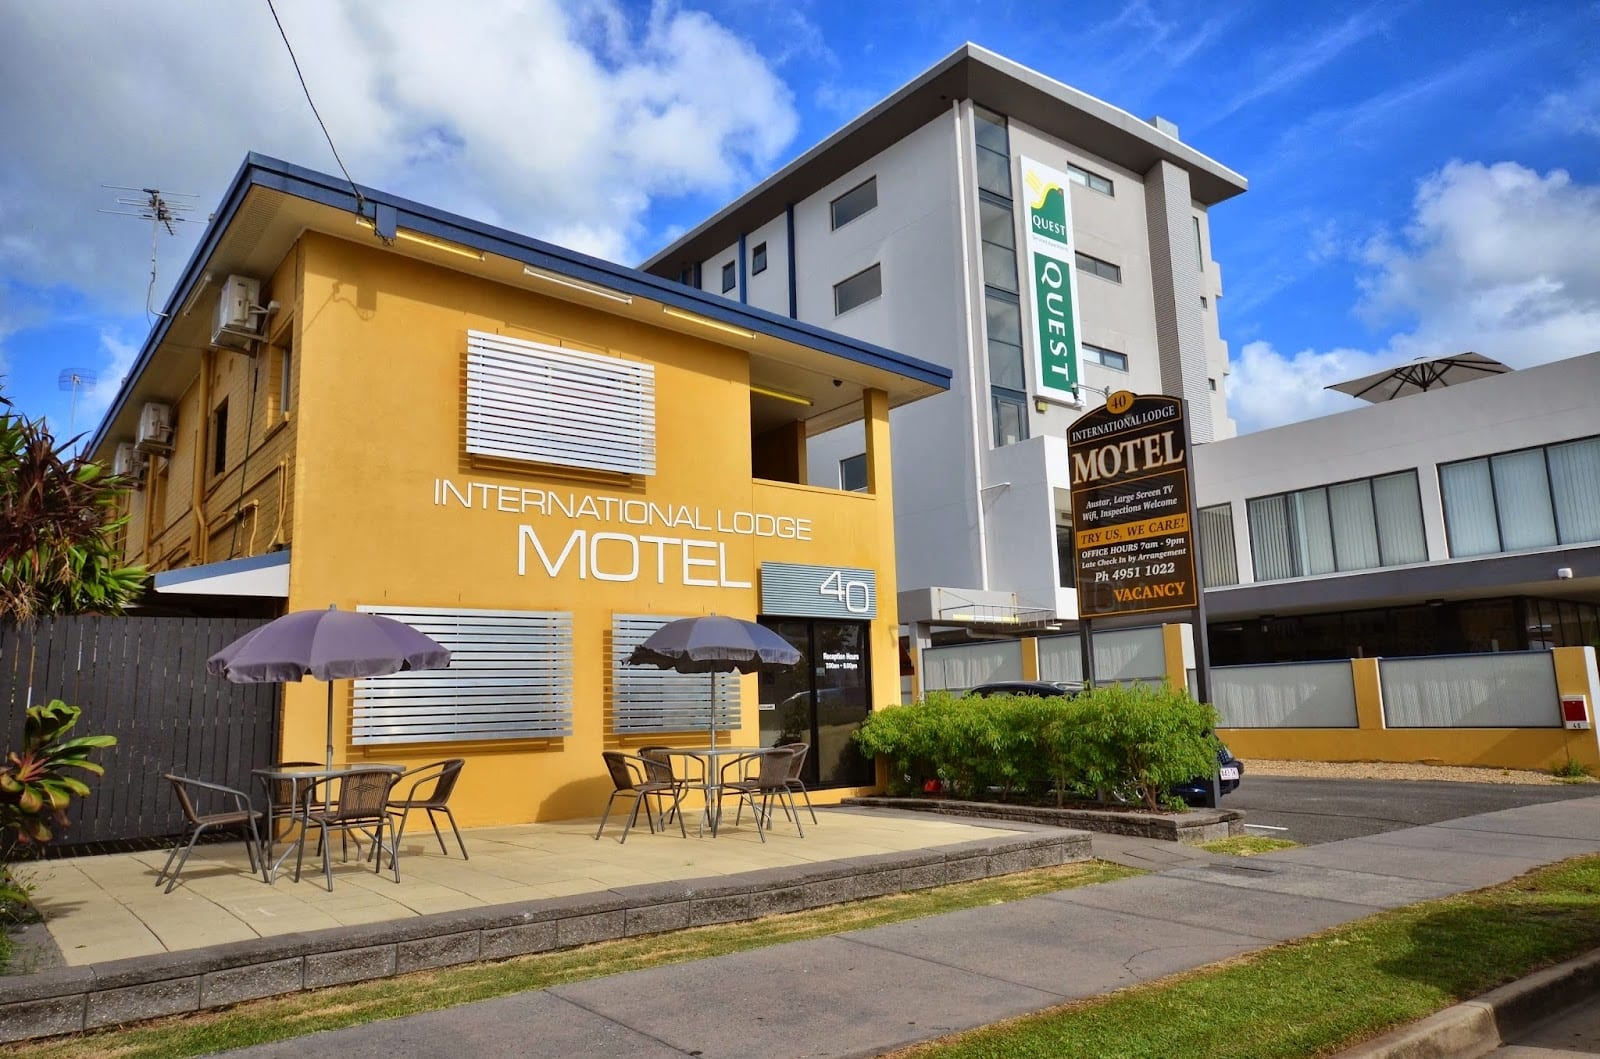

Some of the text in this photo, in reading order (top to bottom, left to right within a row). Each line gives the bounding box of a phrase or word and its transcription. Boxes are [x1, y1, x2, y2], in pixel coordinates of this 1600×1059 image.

[1033, 215, 1066, 236] QUEST
[1041, 261, 1069, 382] QUEST
[1111, 395, 1126, 409] 40
[1072, 405, 1176, 442] INTERNATIONAL LODGE
[1072, 430, 1184, 485] MOTEL
[434, 478, 813, 541] INTERNATIONAL LODGE
[1082, 497, 1178, 522] Wifi, Inspections Welcome
[1086, 485, 1174, 510] Austar, Large Screen TV
[1081, 517, 1185, 545] TRY US, WE CARE!
[517, 524, 752, 589] MOTEL
[1081, 548, 1109, 559] OFFICE
[1110, 543, 1138, 555] HOURS
[1140, 541, 1159, 549] 7am
[1165, 537, 1185, 547] 9pm
[1081, 548, 1187, 569] Late Check In by Arrangement
[1095, 562, 1175, 582] Ph 4951 1022
[820, 570, 869, 613] 40
[1113, 582, 1186, 602] VACANCY
[846, 652, 860, 660] Hours
